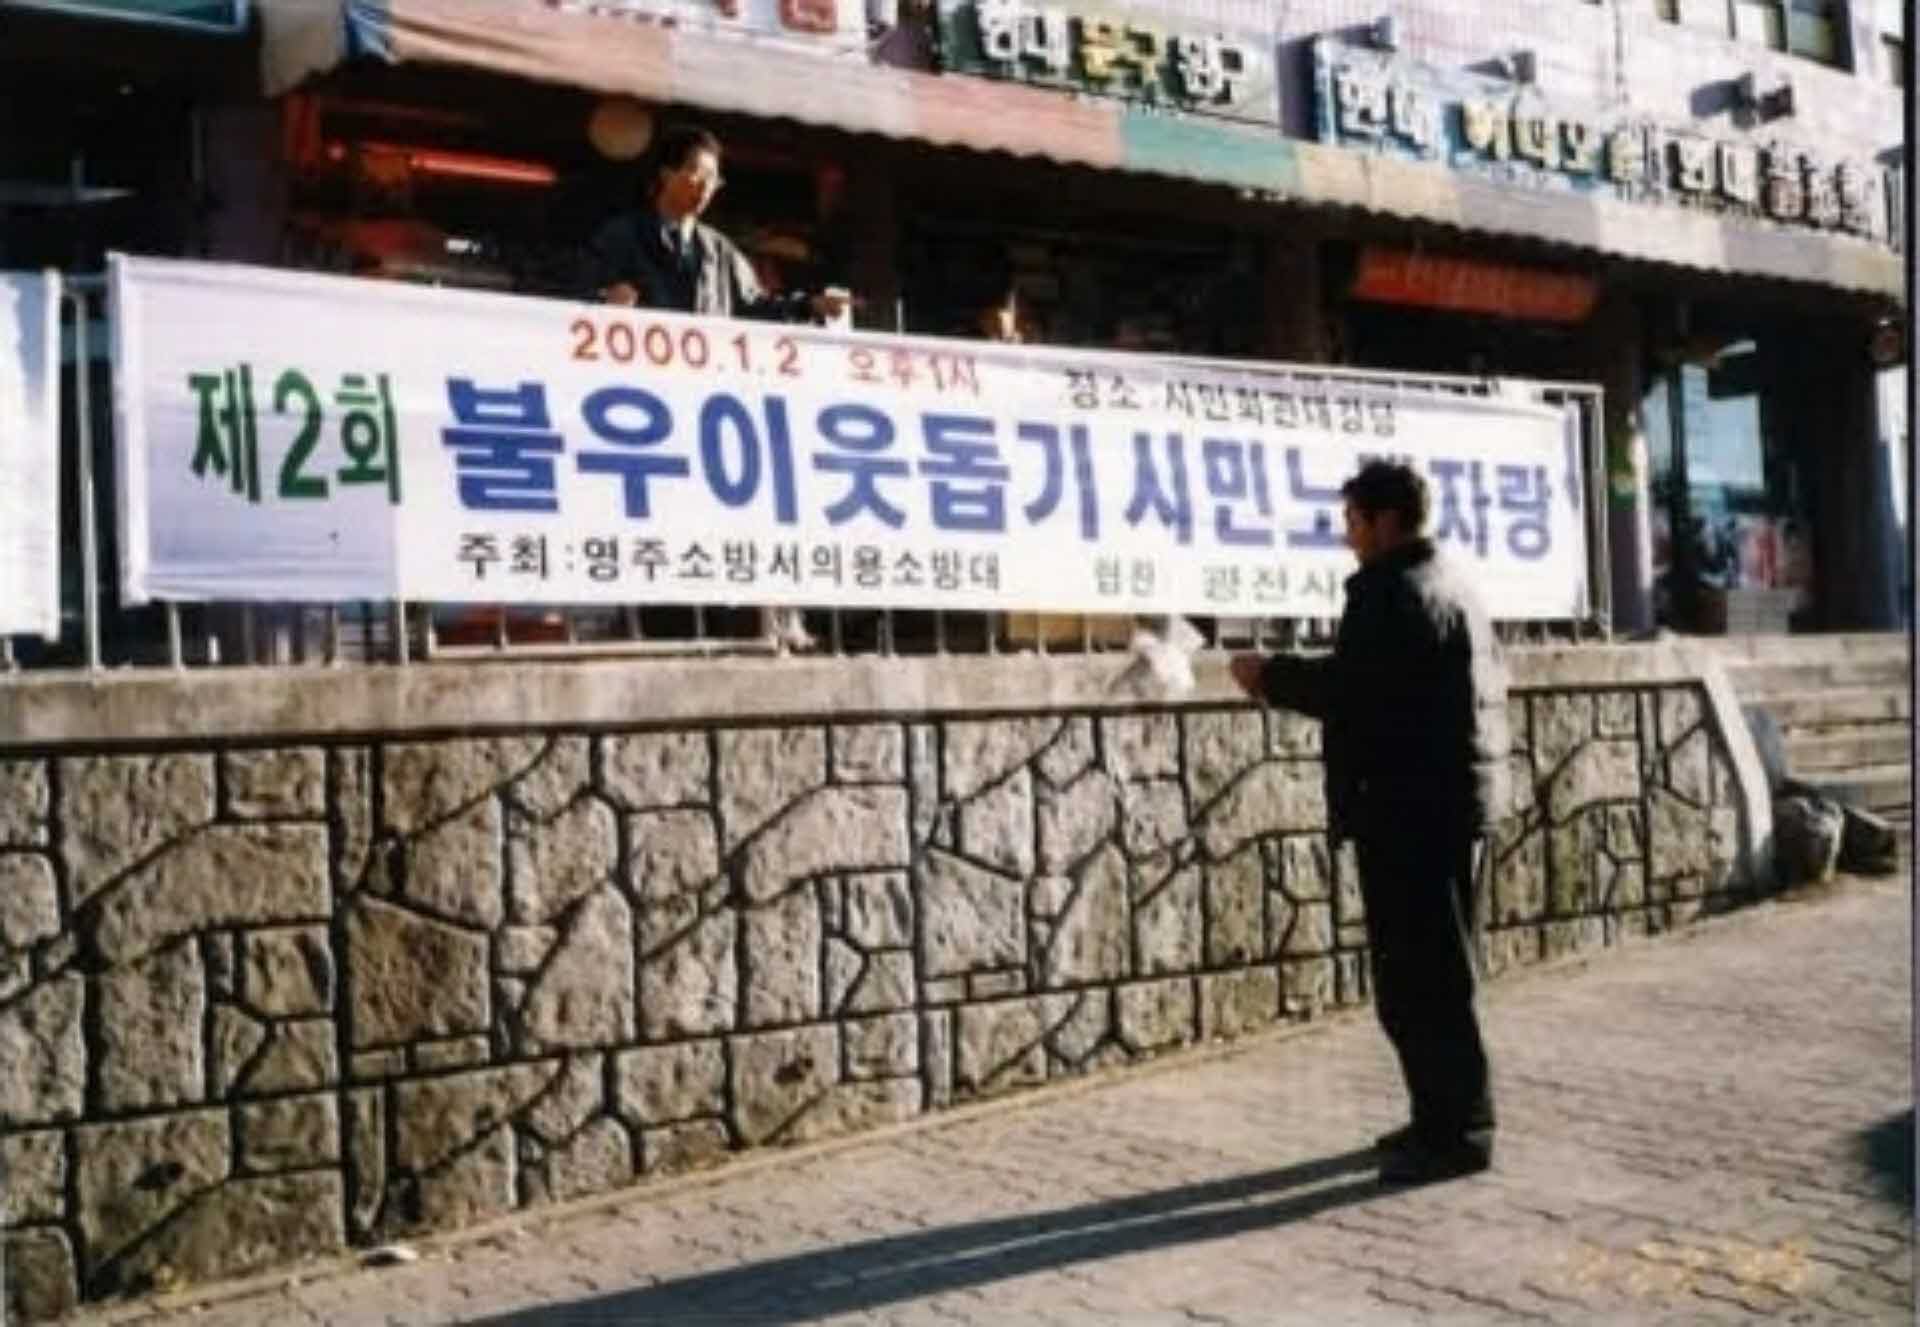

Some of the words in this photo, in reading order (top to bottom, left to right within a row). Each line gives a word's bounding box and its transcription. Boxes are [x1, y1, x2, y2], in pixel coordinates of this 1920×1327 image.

[570, 319, 804, 378] 2000.1.2
[188, 362, 402, 504] 제2회
[440, 376, 1101, 543] 불우이웃돕기
[1123, 430, 1554, 562] 시민노자랑
